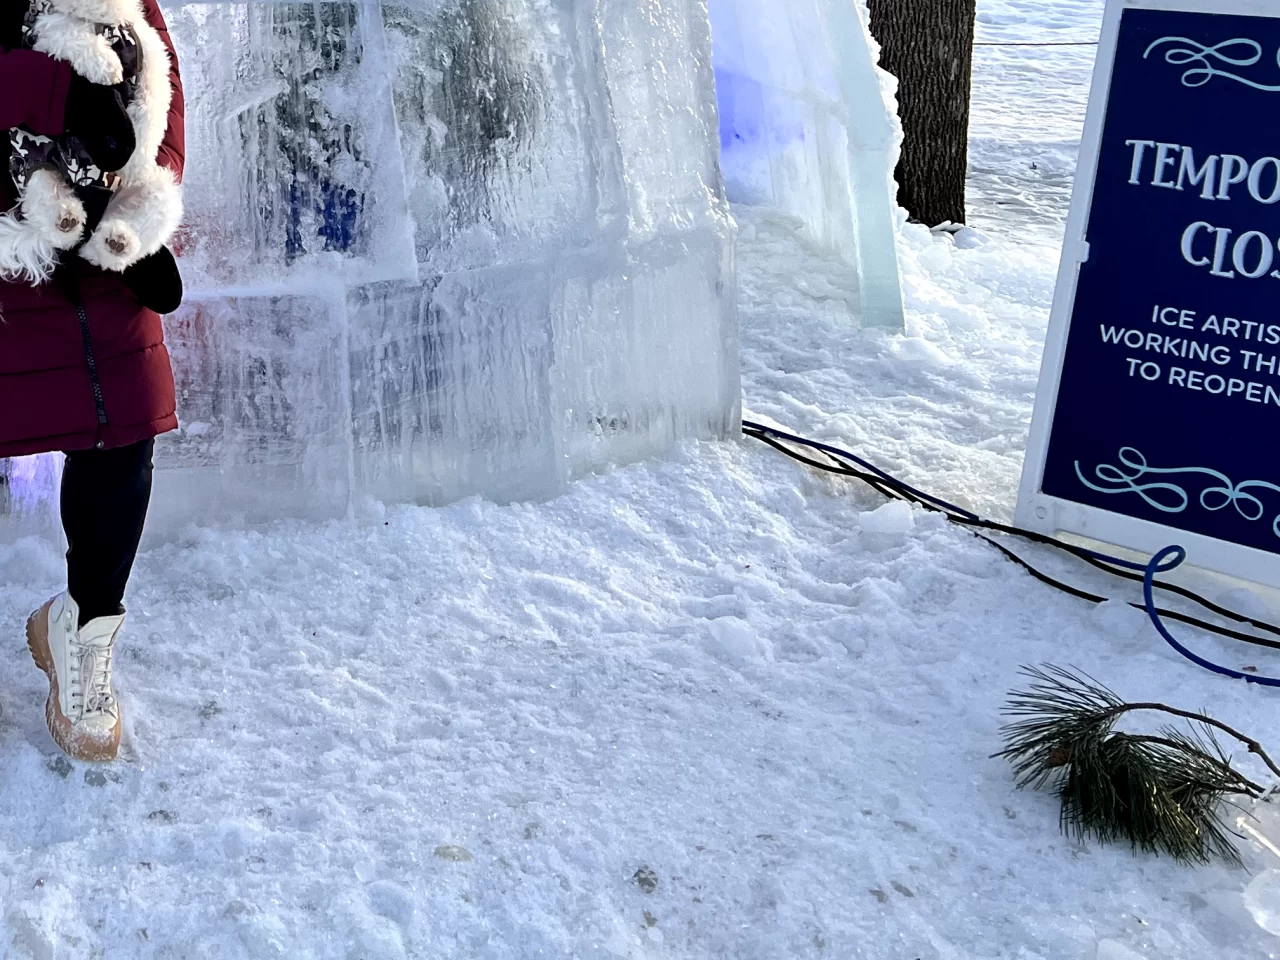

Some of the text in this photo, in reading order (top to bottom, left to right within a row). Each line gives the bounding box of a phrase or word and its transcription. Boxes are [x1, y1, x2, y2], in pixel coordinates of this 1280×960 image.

[1125, 139, 1280, 204] TEMPO
[1180, 221, 1280, 280] CLO
[1100, 324, 1280, 377] WORKING TH
[1151, 305, 1280, 345] ICE ARTIS
[1126, 357, 1280, 408] TO REOPEN
